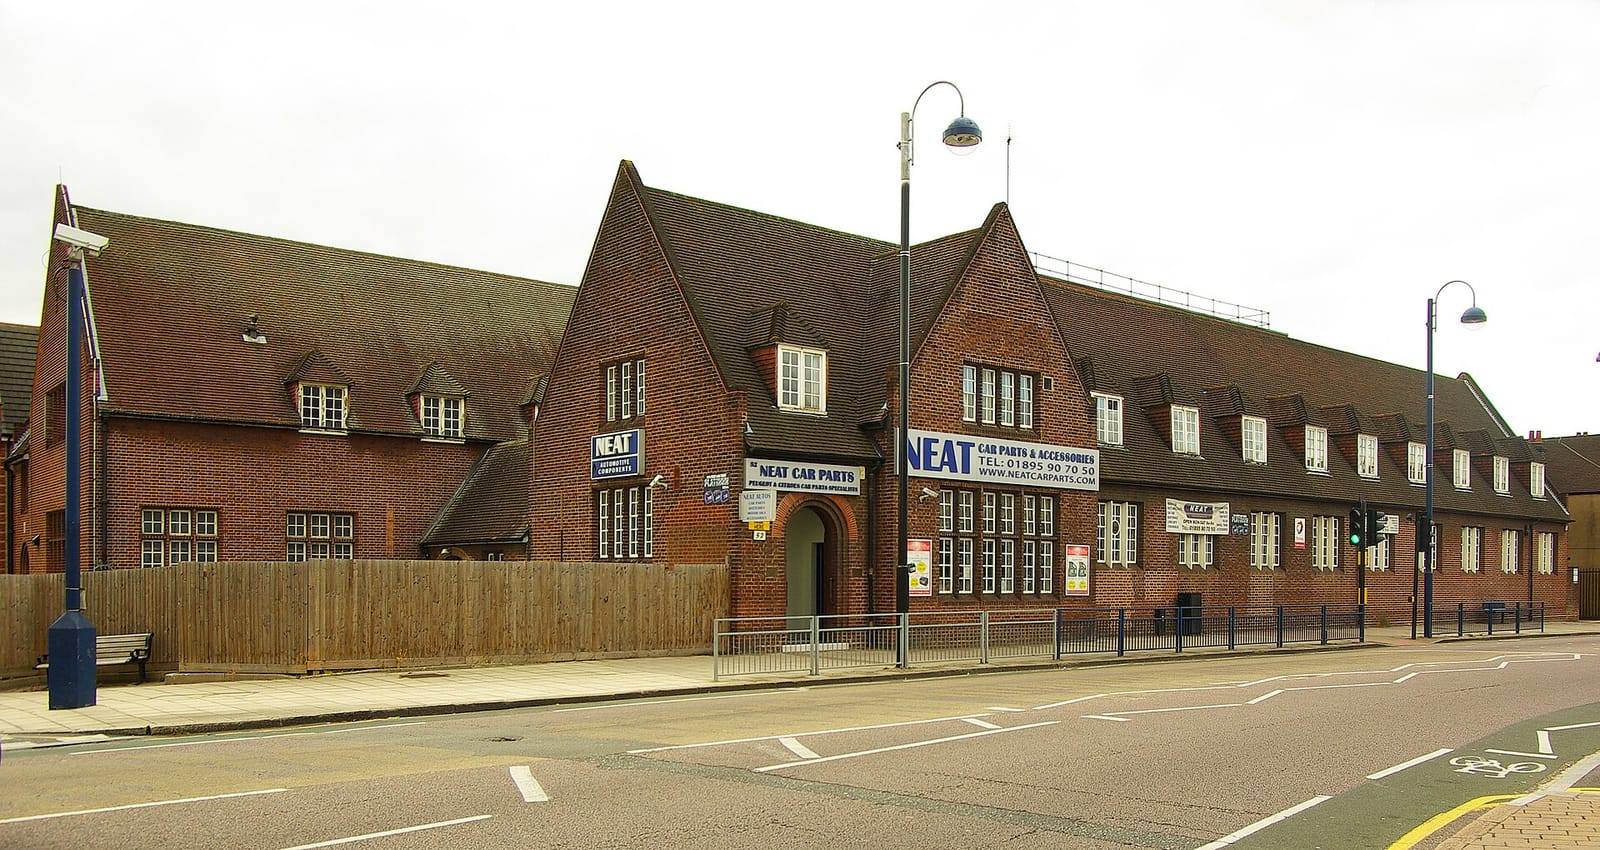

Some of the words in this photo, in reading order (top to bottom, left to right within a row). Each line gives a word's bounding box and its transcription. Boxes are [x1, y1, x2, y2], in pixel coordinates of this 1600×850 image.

[596, 434, 632, 456] NEAT
[978, 443, 997, 454] CAR
[999, 446, 1028, 458] PARTS
[1029, 449, 1036, 458] &
[1038, 450, 1094, 464] ACCESSORIES
[600, 458, 630, 468] AUTOMOTIVE
[908, 436, 975, 474] NEAT
[598, 466, 632, 474] COMPONENTS
[760, 465, 790, 478] NEAT
[792, 467, 816, 480] CAR
[819, 469, 855, 483] PARTS
[978, 456, 1004, 467] TEL:
[1007, 460, 1043, 470] 01895
[1048, 464, 1061, 472] 90
[1065, 465, 1078, 474] 70
[1082, 466, 1095, 475] 50
[978, 468, 1096, 485] WWW.NEATCARPARTS.COM
